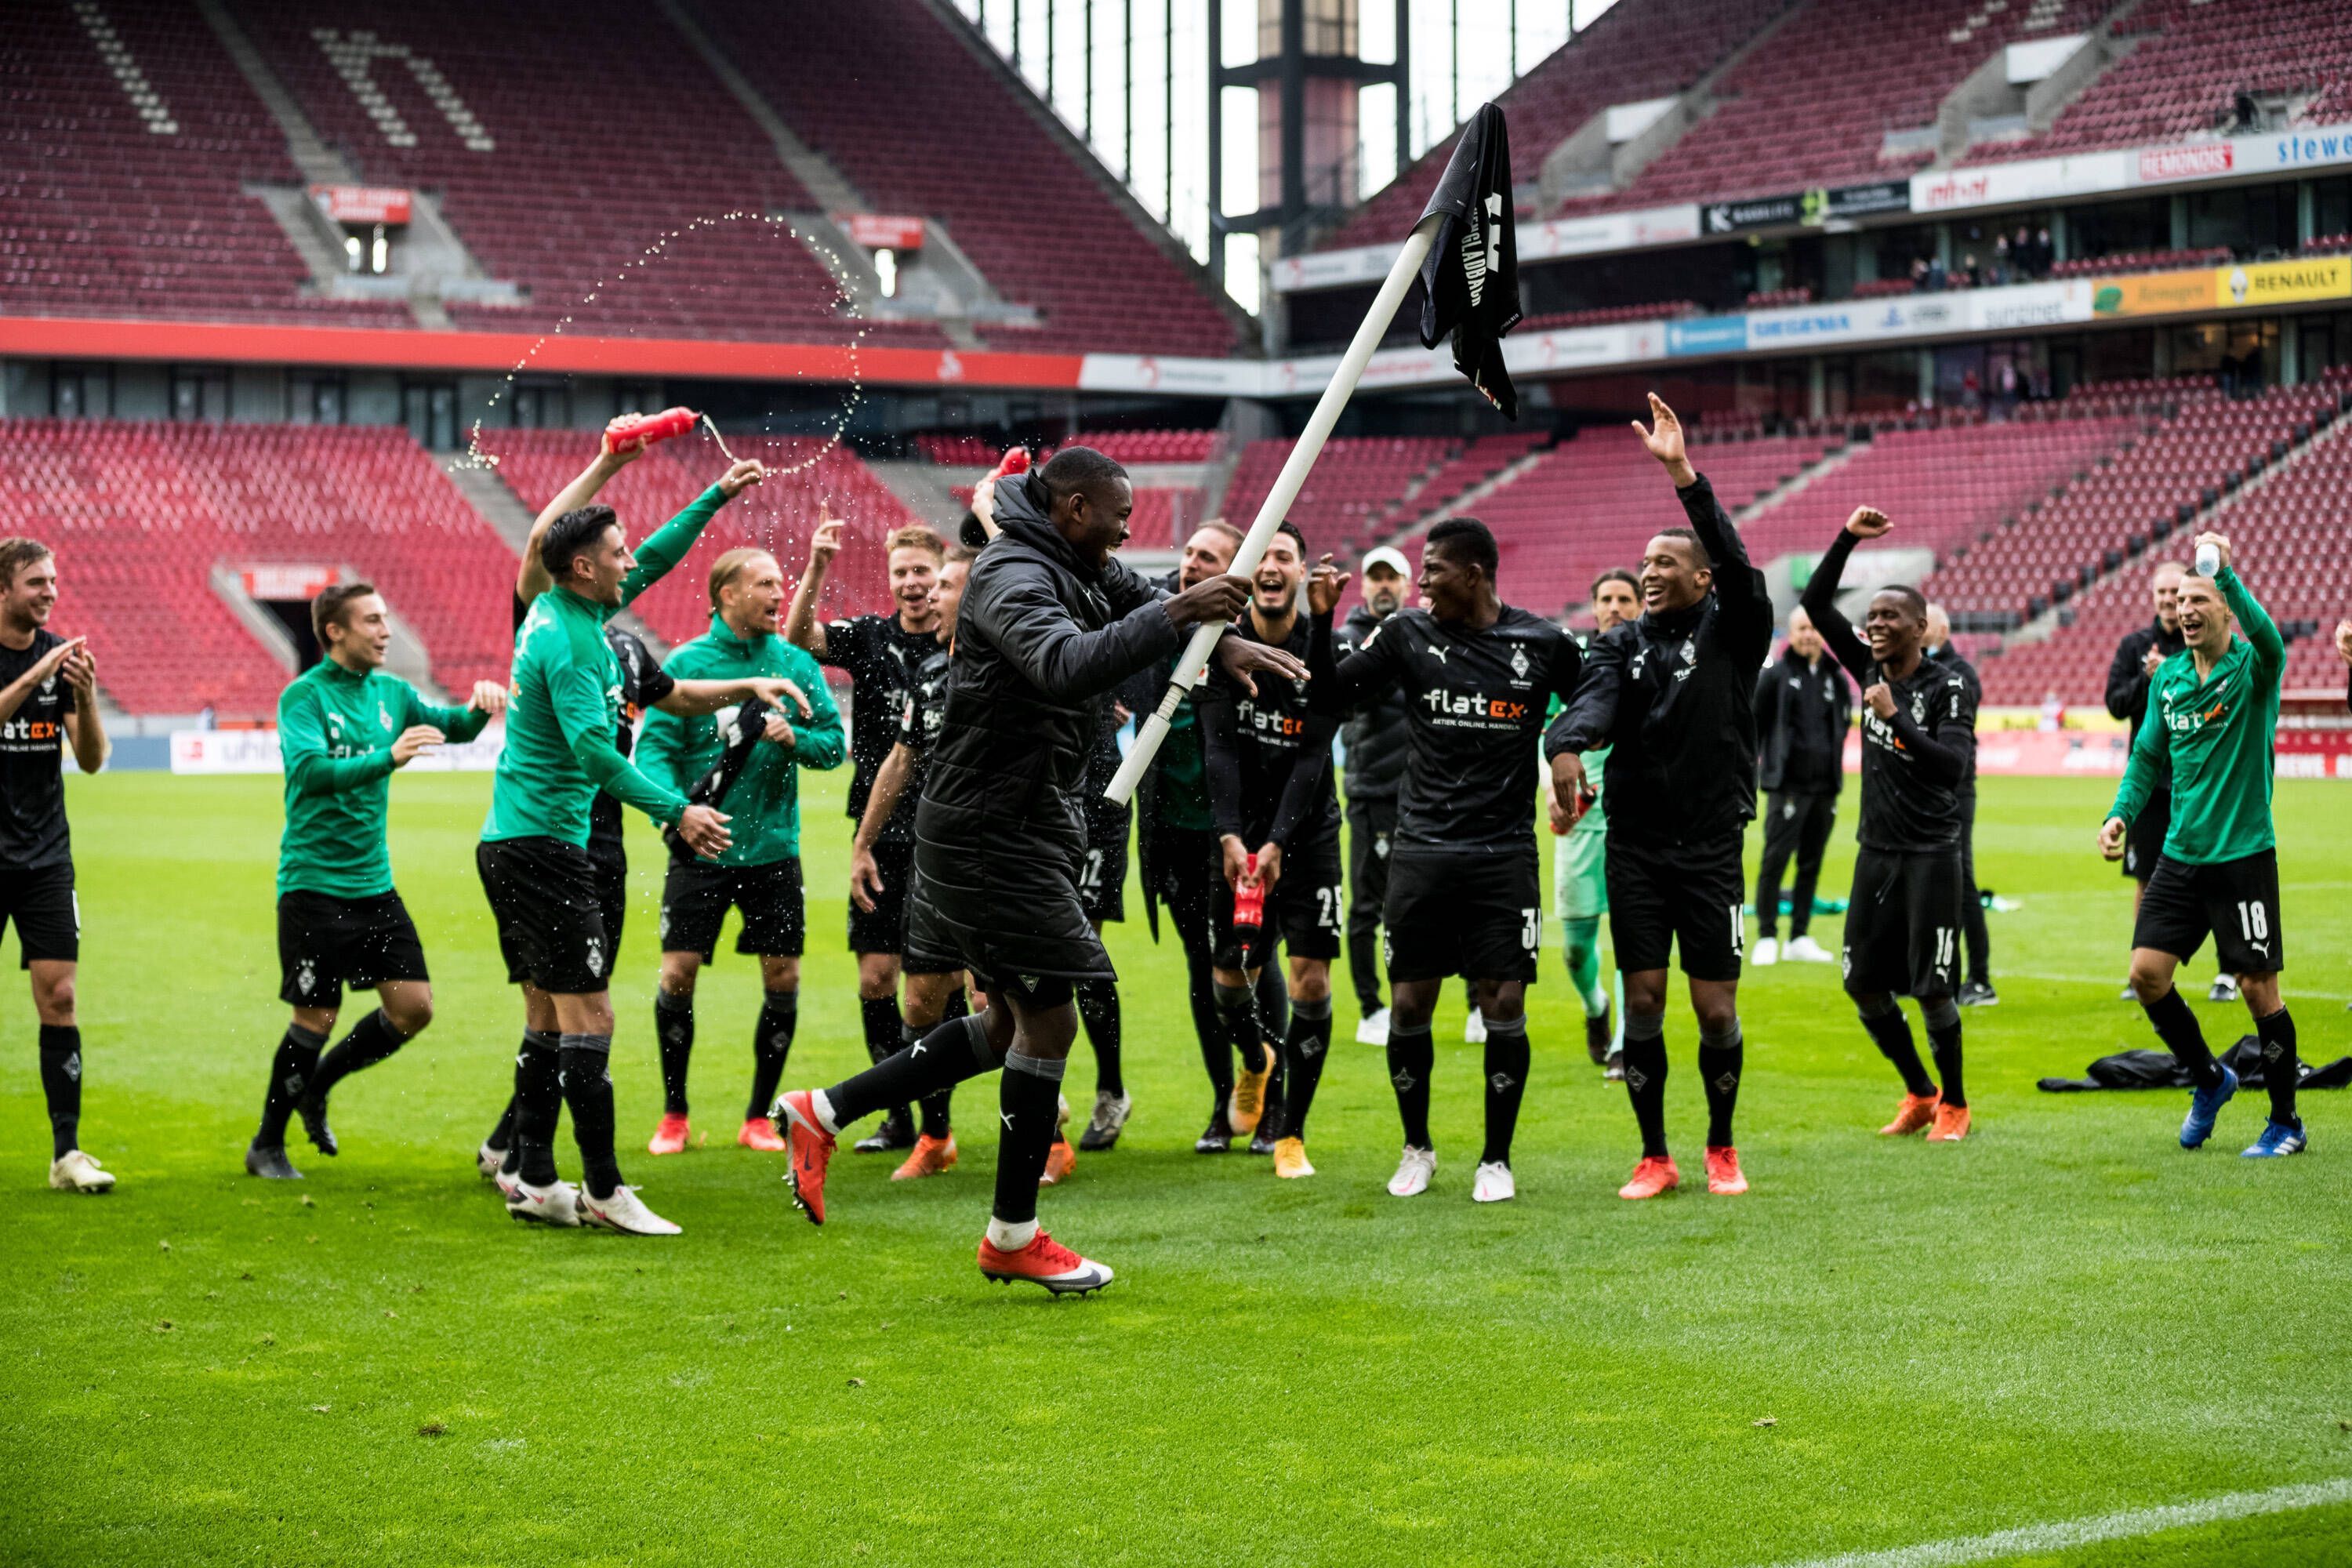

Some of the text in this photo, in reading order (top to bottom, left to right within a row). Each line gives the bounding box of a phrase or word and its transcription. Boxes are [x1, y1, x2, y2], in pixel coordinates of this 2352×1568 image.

[2255, 270, 2339, 290] RENAULT
[0, 716, 56, 739] atex
[1457, 720, 1486, 729] ONLINE.
[1080, 848, 1102, 887] 2
[2238, 900, 2268, 941] 18
[1935, 927, 1954, 967] 16
